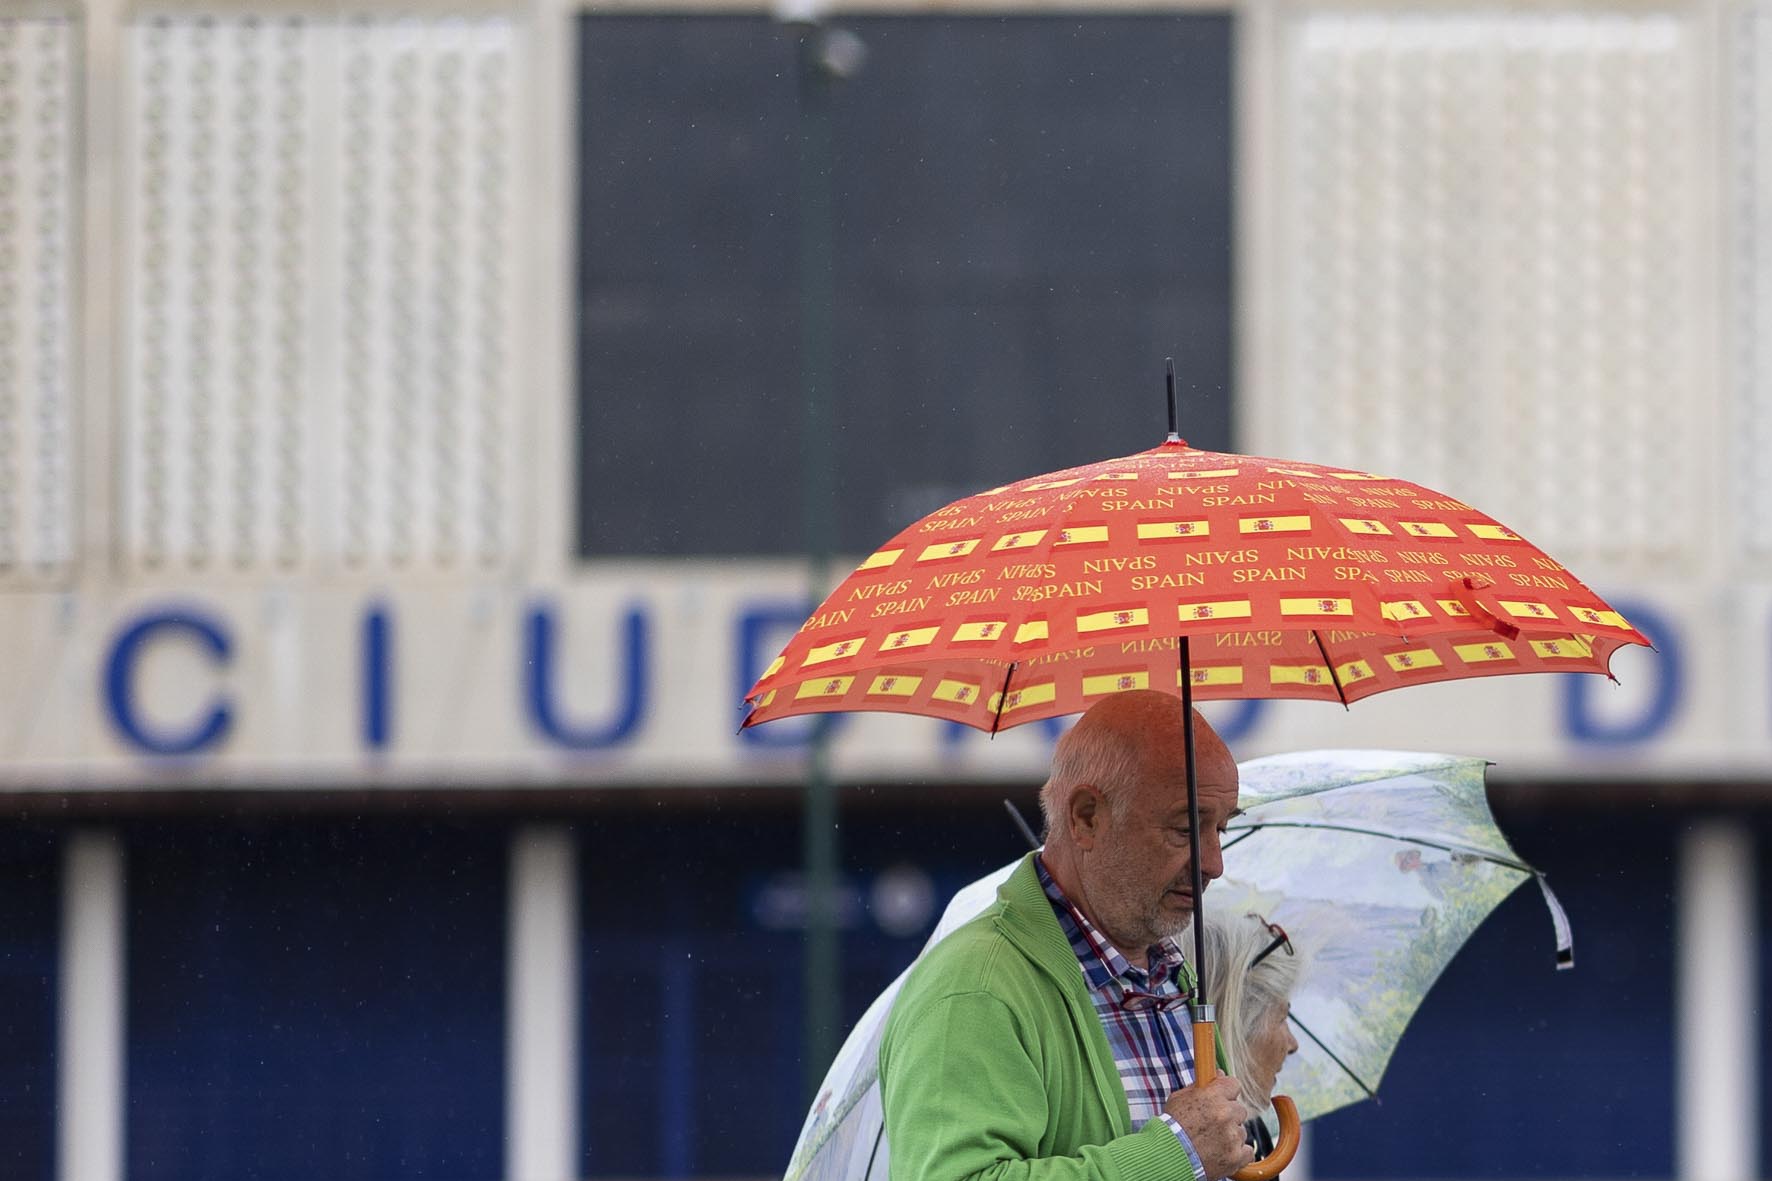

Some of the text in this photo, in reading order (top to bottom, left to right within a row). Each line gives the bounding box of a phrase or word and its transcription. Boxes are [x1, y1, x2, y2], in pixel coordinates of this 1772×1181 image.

[1158, 484, 1230, 496] SPAIN
[1101, 493, 1275, 512] SPAIN SPAIN
[920, 516, 984, 533] SPAIN
[1083, 556, 1156, 574] SPAIN
[1186, 550, 1258, 566] SPAIN
[1397, 551, 1448, 565] SPAIN
[1459, 553, 1517, 568] SPAIN
[925, 568, 985, 590] SPAIN
[1131, 572, 1205, 591] SPAIN
[1233, 566, 1307, 583] SPAIN
[1384, 570, 1433, 583] SPAIN
[1509, 574, 1569, 590] SPAIN
[848, 579, 912, 602] SPAIN
[870, 596, 932, 618] SPAIN
[945, 588, 1002, 607] SPAIN
